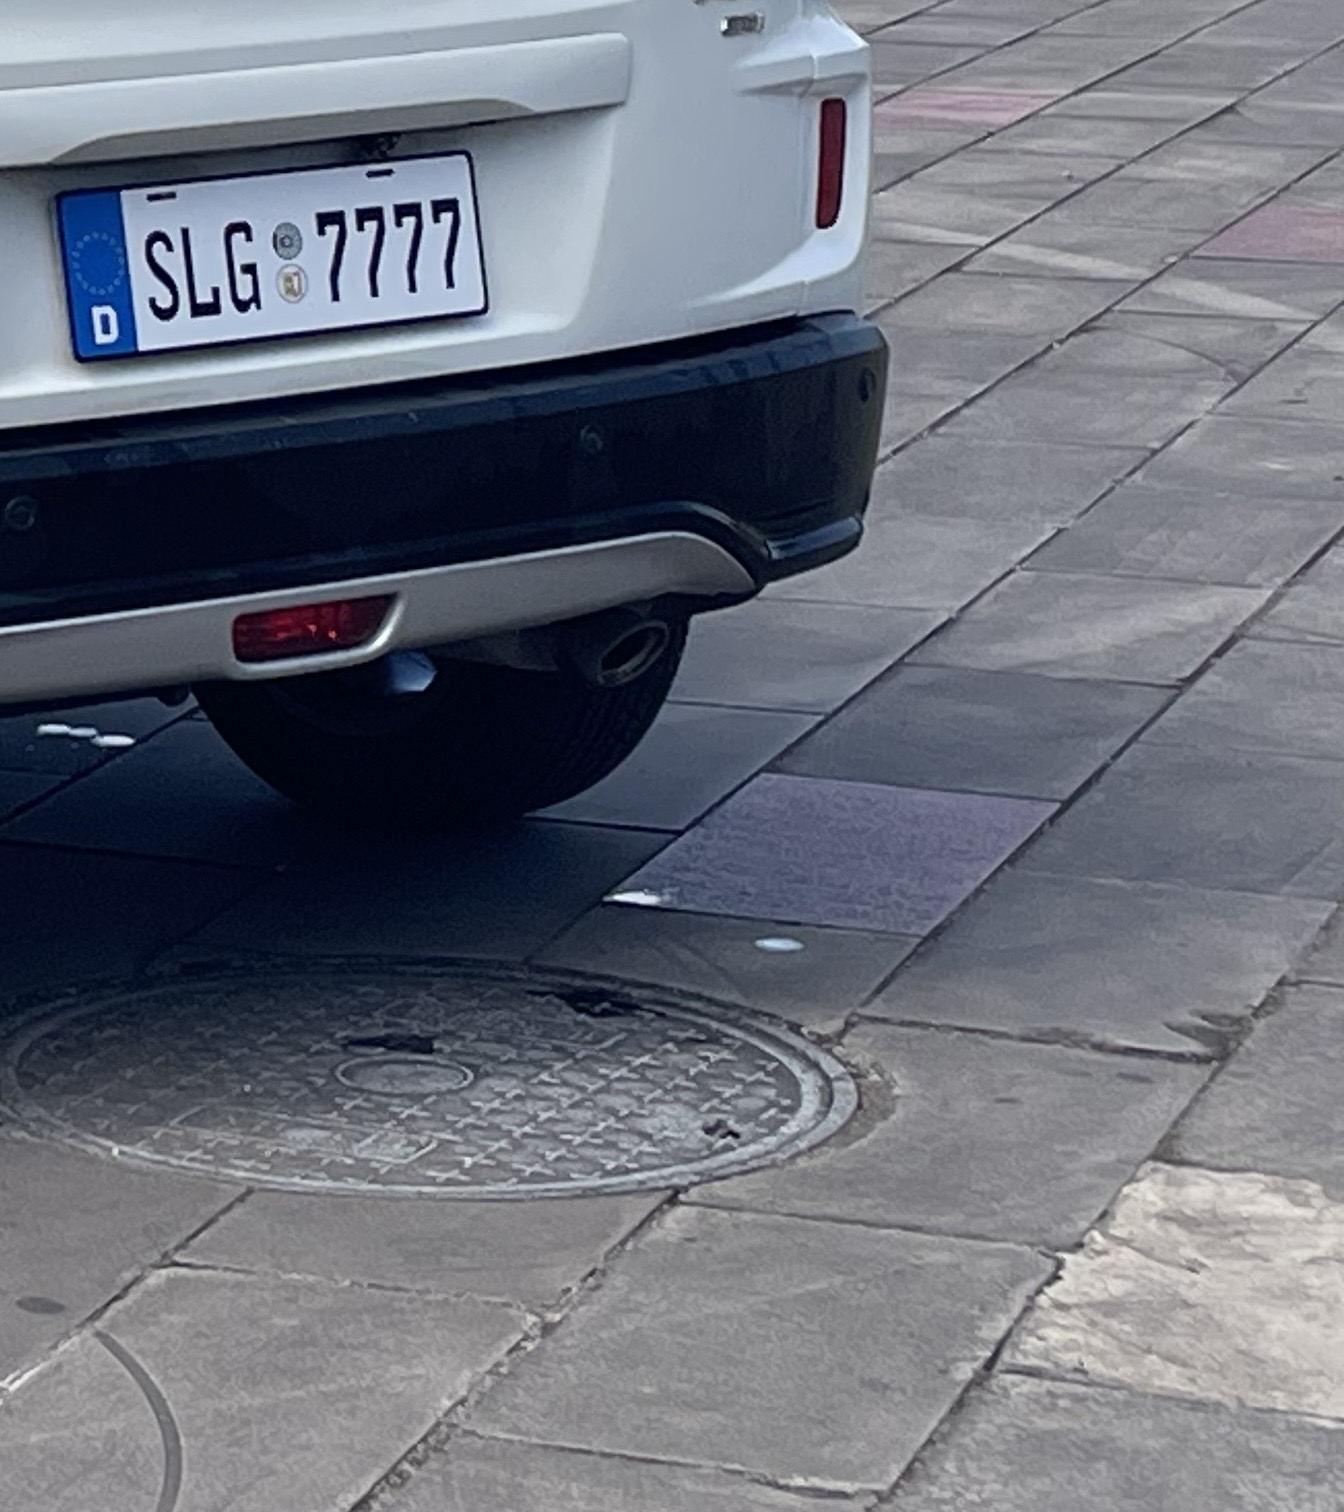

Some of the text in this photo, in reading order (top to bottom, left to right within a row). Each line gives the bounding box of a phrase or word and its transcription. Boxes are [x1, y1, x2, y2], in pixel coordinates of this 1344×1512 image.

[144, 197, 461, 322] SLG 7777
[91, 304, 119, 345] D
